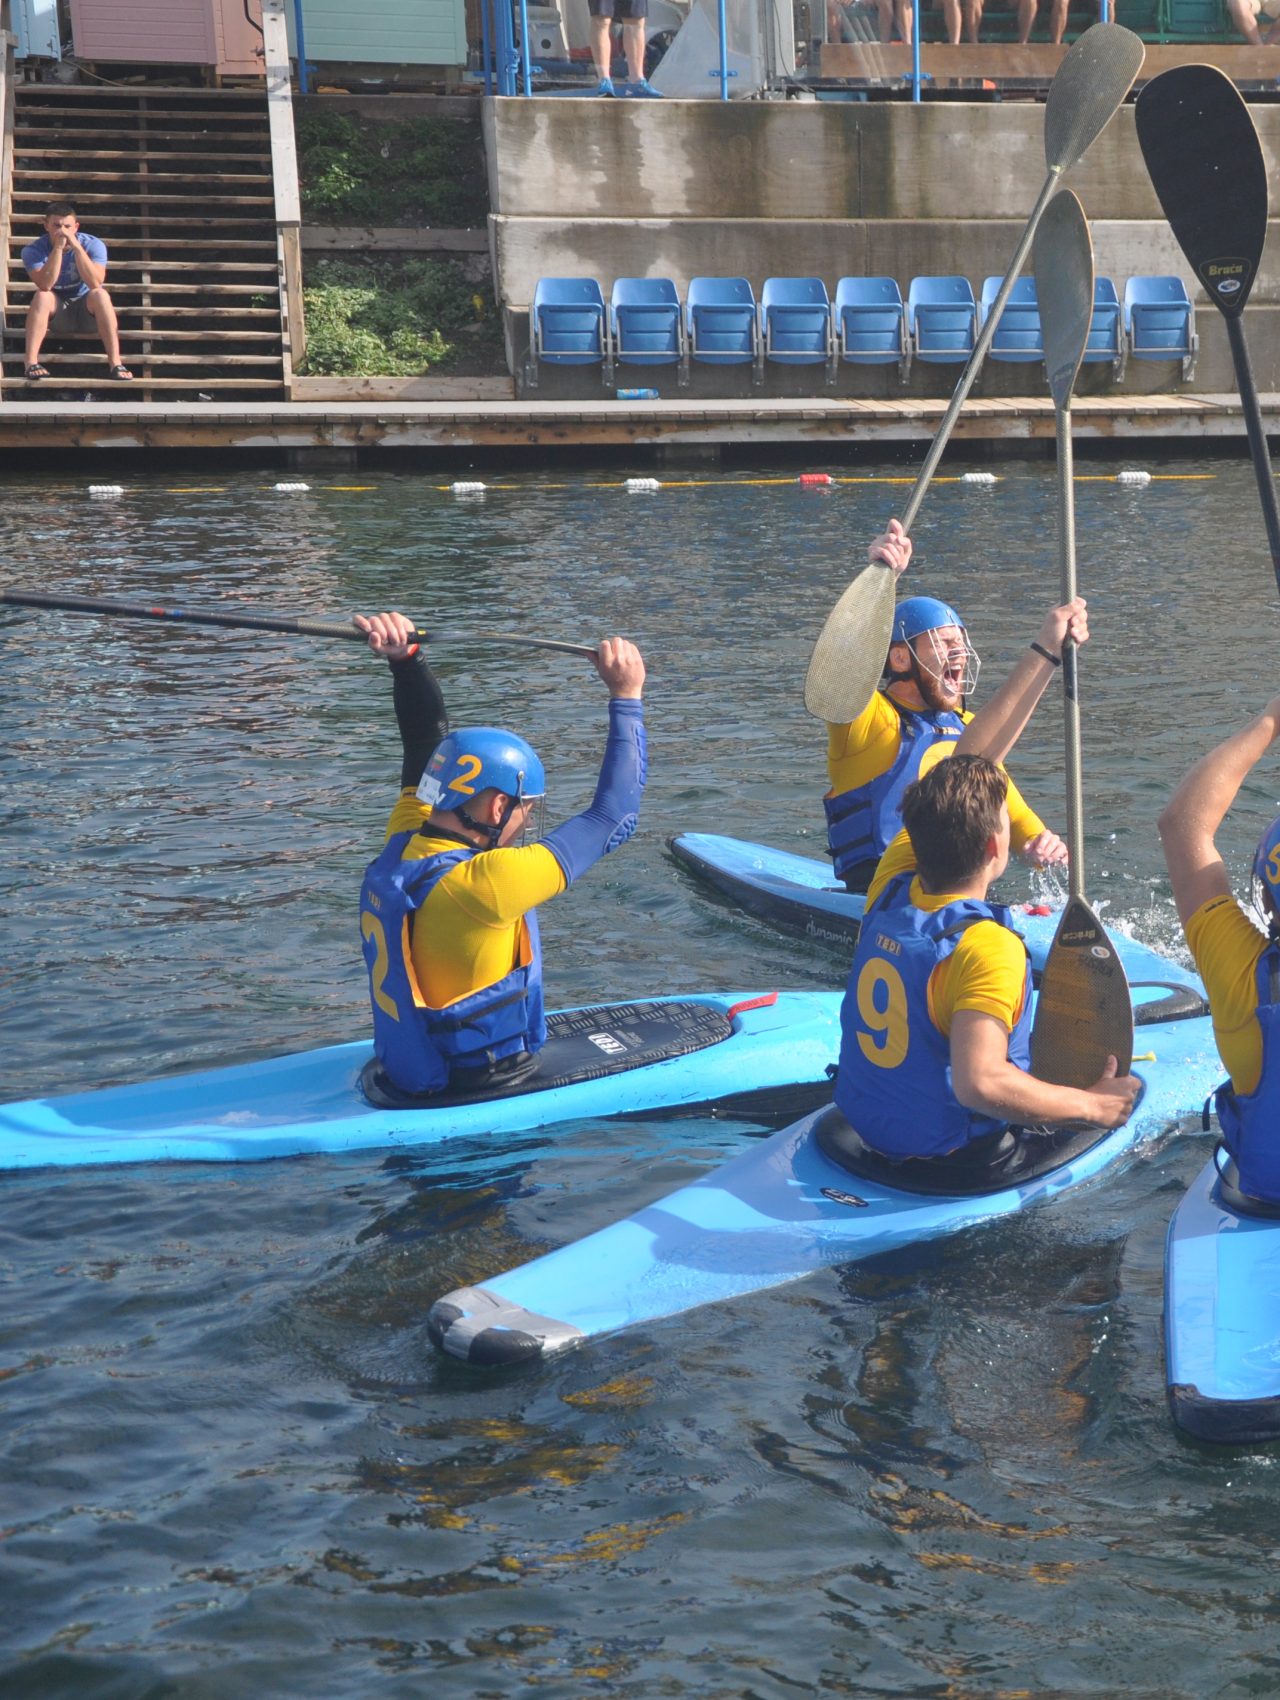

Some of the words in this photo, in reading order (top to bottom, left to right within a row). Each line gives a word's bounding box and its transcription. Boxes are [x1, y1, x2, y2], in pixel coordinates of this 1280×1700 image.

[448, 754, 483, 795] 2
[361, 910, 399, 1022] 2
[856, 957, 909, 1069] 9
